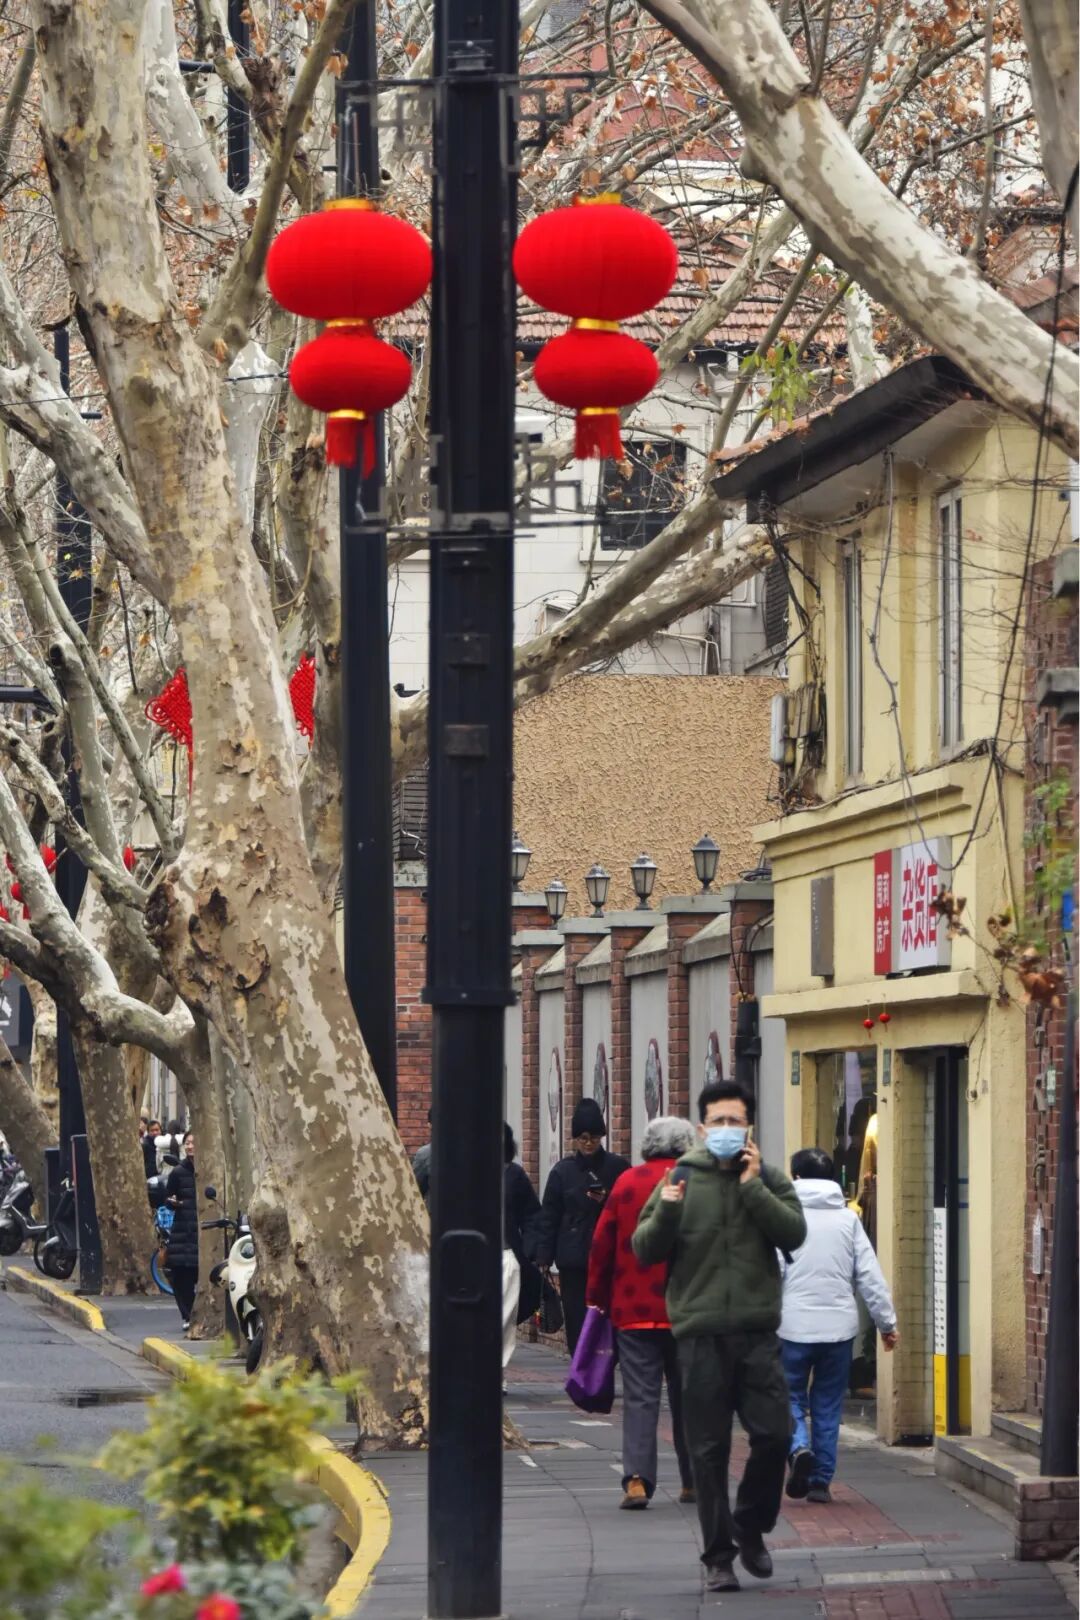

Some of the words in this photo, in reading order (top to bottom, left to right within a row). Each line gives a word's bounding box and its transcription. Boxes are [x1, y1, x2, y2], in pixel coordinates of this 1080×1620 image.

[877, 916, 890, 953] 房产
[902, 858, 937, 952] 杂货店
